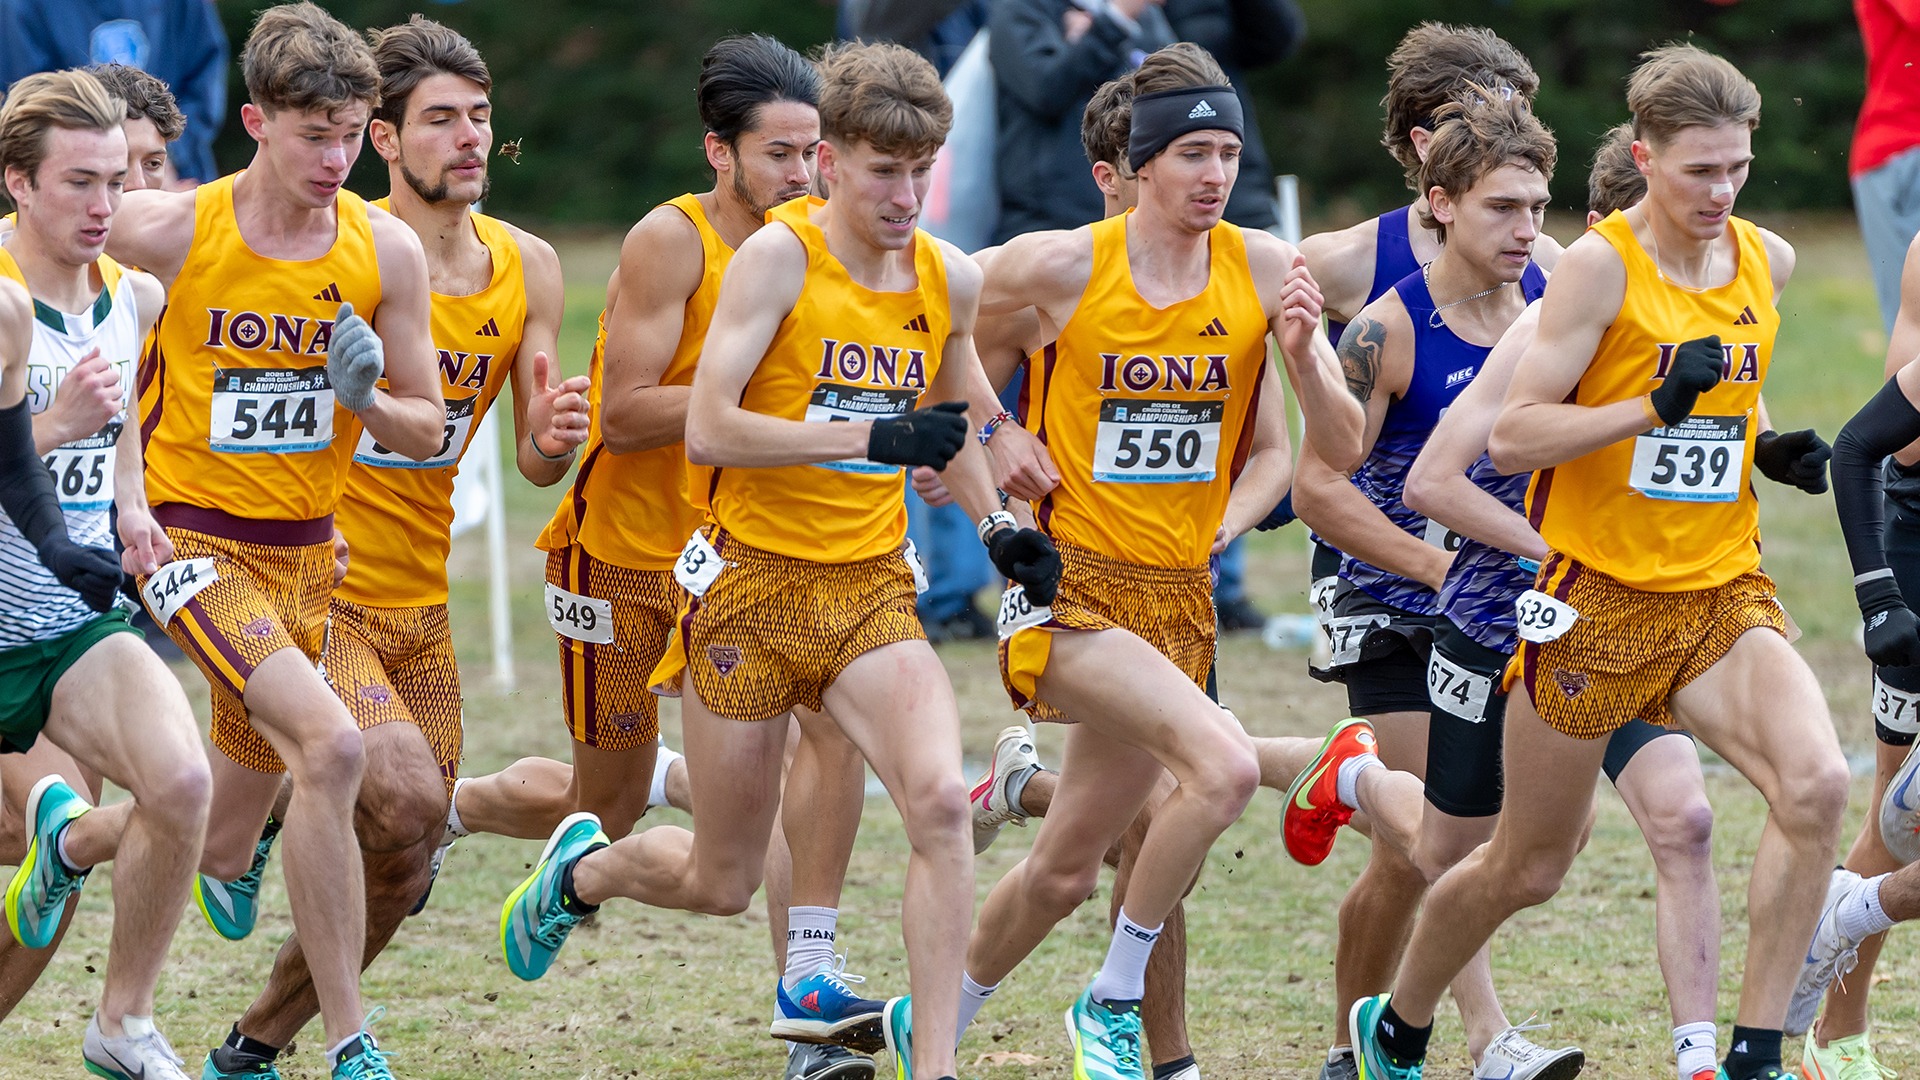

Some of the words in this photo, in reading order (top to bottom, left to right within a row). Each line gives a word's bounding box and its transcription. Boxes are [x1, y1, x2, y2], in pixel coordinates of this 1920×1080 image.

[1188, 110, 1217, 119] adidas
[203, 307, 335, 355] IONA
[437, 349, 494, 390] NA
[814, 337, 927, 389] IONA
[1097, 352, 1232, 393] IONA
[1446, 366, 1474, 385] NEC
[1649, 342, 1760, 383] INA
[243, 381, 311, 392] CHAMPIONSHIPS
[839, 399, 896, 412] CHAMPIONSHIPS
[231, 397, 317, 439] 544
[1129, 413, 1198, 423] CHAMPIONSHIPS
[1668, 428, 1728, 439] CHAMPIONSHIPS
[1114, 429, 1202, 469] 550
[1651, 444, 1730, 486] 539
[683, 537, 707, 574] 43
[151, 563, 198, 611] 544
[554, 594, 597, 631] 549
[1430, 661, 1471, 705] 674
